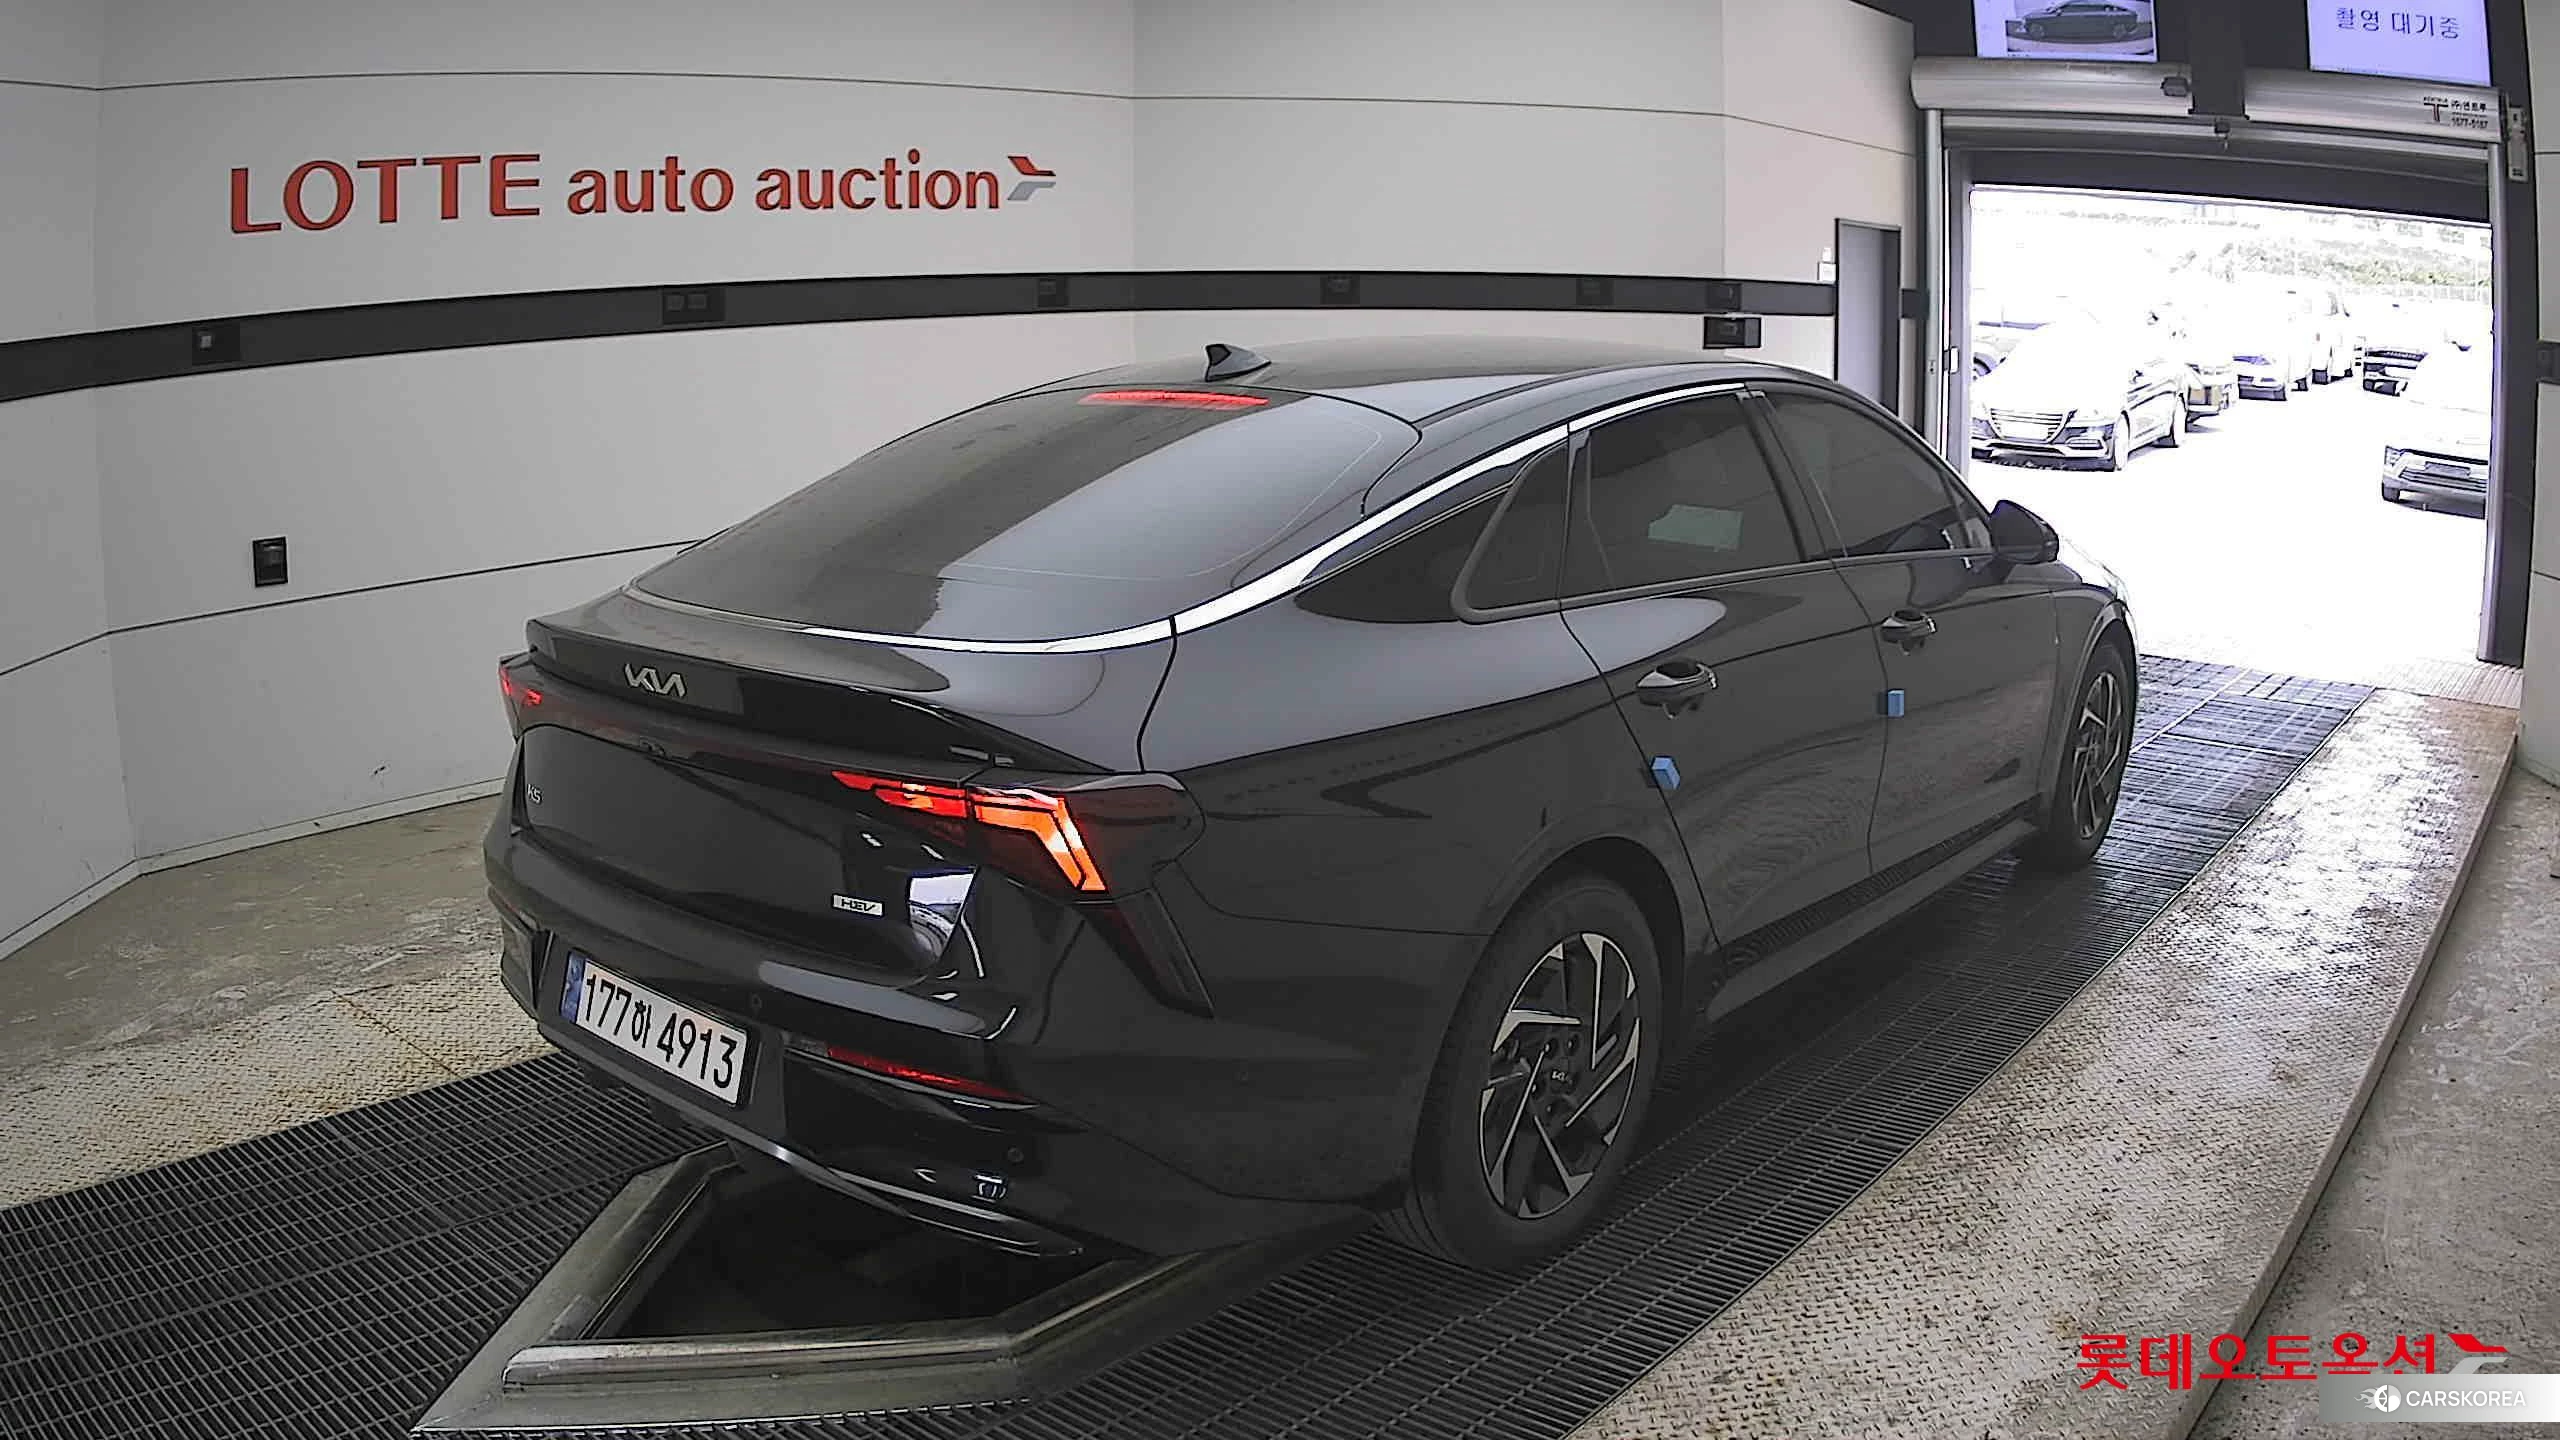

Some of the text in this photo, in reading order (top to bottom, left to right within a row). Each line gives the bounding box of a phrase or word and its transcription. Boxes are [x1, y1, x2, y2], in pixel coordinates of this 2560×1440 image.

[2336, 7, 2459, 39] 촬영 대기중
[231, 151, 1000, 234] LOTTE auto auction
[624, 663, 686, 697] KIA
[586, 974, 738, 1089] 177하 4913
